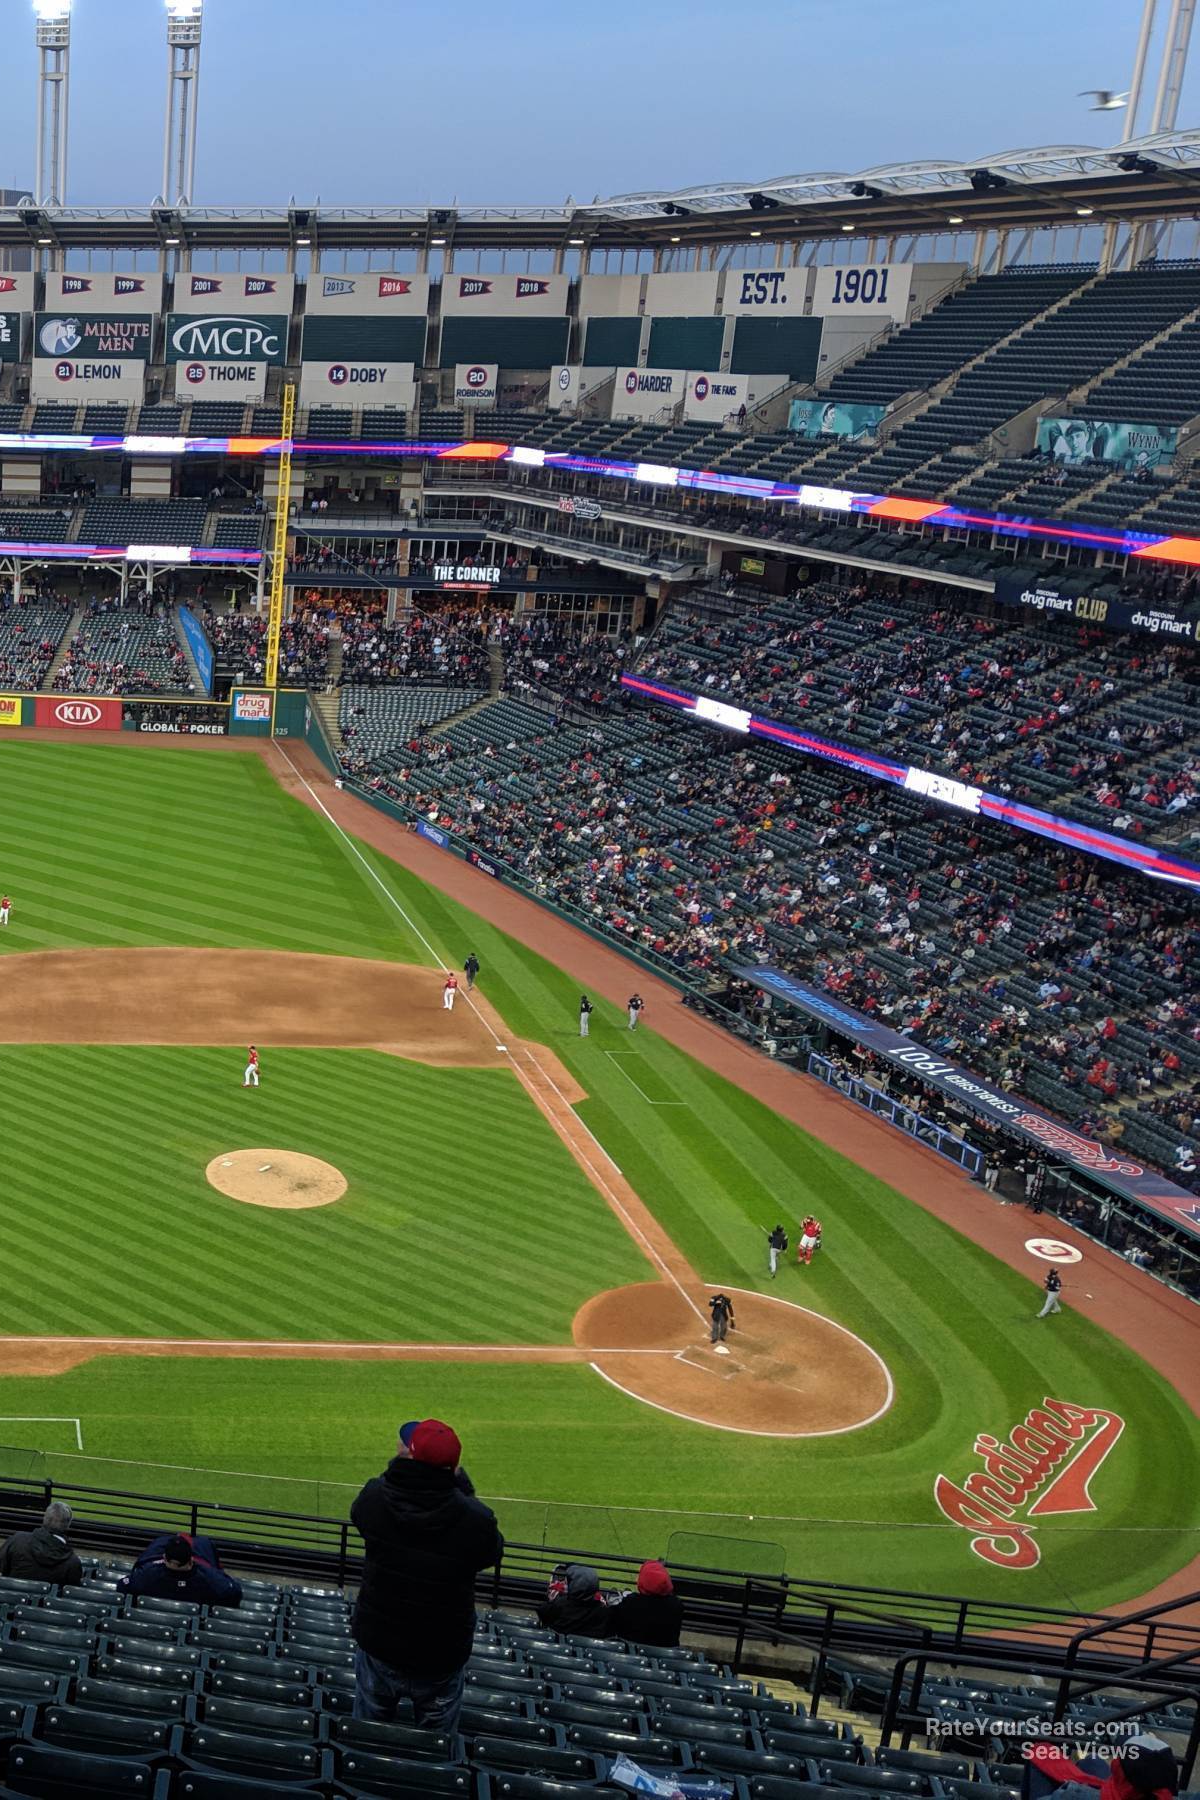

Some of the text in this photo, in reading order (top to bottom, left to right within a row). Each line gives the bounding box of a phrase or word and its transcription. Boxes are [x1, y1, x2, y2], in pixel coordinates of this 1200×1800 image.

[65, 279, 82, 291] 1998
[117, 279, 135, 291] 1999
[194, 280, 211, 291] 2001
[248, 280, 265, 291] 2007
[326, 281, 345, 292] 2013
[382, 281, 401, 292] 2016
[464, 281, 483, 293] 2017
[519, 281, 539, 293] 2018
[740, 271, 788, 305] EST.
[833, 268, 888, 304] 1901
[84, 323, 150, 338] MINUTE
[97, 338, 135, 352] MEN
[59, 365, 122, 380] 21 LEMON
[189, 366, 257, 382] 25 THOME
[332, 368, 387, 383] 14 DOBY
[469, 371, 485, 383] 20
[638, 374, 673, 393] HARDER
[711, 384, 721, 395] THE
[722, 385, 737, 396] FANS
[456, 388, 495, 398] ROBINSON
[434, 565, 500, 583] THE CORNER
[1020, 590, 1108, 622] drug mart CLUB
[1131, 612, 1160, 632] drug
[1160, 620, 1192, 635] mart
[238, 694, 265, 709] drug
[63, 706, 93, 721] KIA
[240, 707, 272, 717] mart
[140, 722, 224, 735] GLOBAL POKER
[275, 728, 289, 736] 325
[888, 1046, 1019, 1114] ESTABLISHED 1901
[934, 1396, 1125, 1570] Indians
